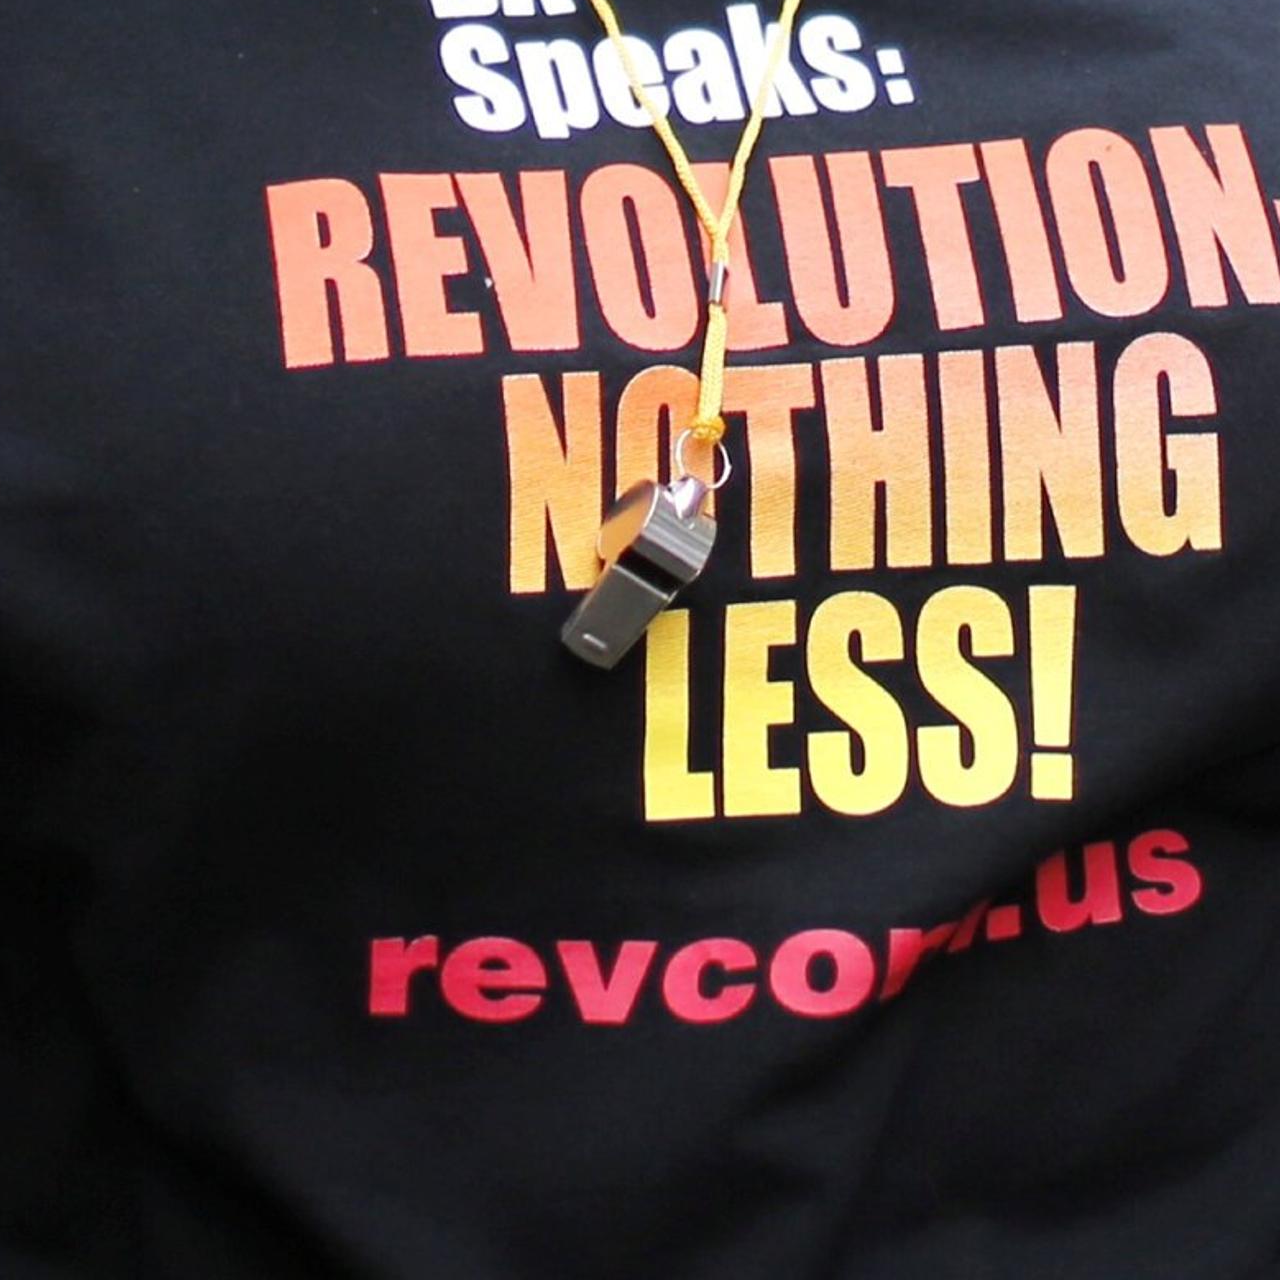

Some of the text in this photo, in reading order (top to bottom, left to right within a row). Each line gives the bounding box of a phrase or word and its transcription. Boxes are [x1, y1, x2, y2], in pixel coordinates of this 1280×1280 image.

[440, 3, 915, 139] Speaks:
[502, 332, 1223, 593] NOTHING
[644, 584, 1077, 821] LESS!
